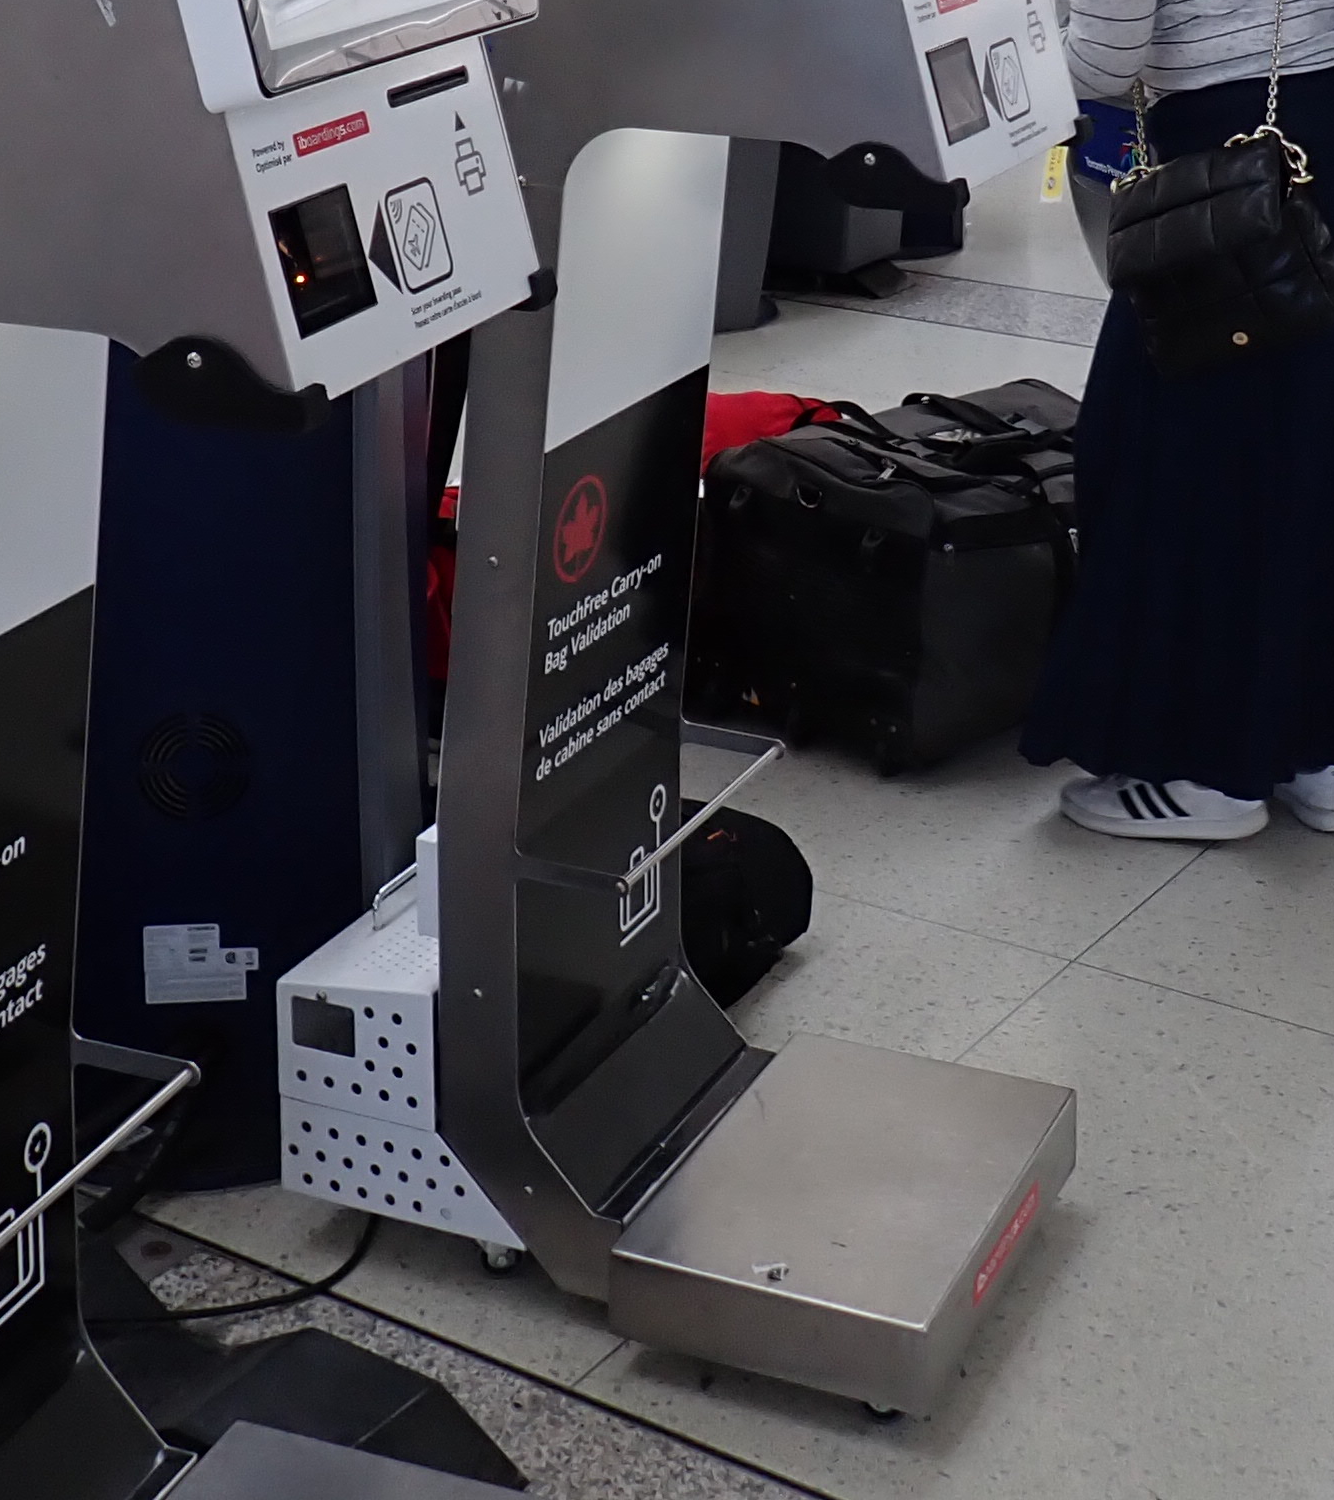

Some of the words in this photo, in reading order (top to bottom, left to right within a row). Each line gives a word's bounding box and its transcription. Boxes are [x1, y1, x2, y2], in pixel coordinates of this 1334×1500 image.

[298, 117, 366, 150] iboardings.com
[544, 648, 568, 675] Bag
[570, 602, 631, 656] Validation
[547, 591, 609, 641] TouchFree
[611, 553, 663, 596] Carry-on
[535, 755, 552, 782] de
[554, 728, 595, 768] cabine
[596, 707, 623, 735] sans
[624, 670, 666, 713] contact
[538, 693, 602, 749] Validation
[603, 677, 625, 704] des
[625, 642, 670, 683] bagages
